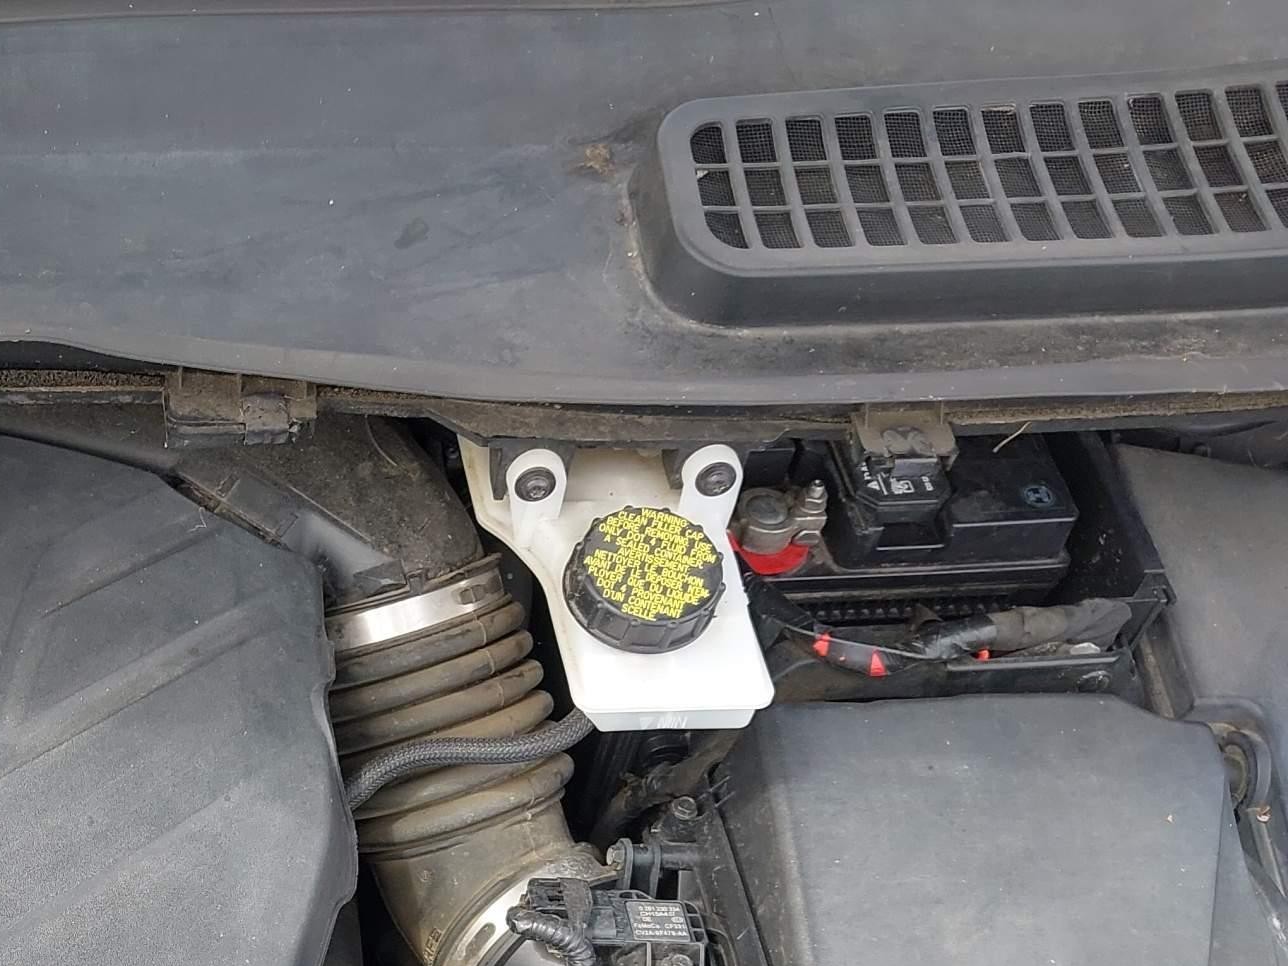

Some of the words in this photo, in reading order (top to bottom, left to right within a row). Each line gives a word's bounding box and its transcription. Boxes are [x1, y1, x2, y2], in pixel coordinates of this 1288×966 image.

[606, 517, 640, 533] BEFORE
[695, 541, 712, 553] USE
[618, 511, 648, 525] CLEAN
[651, 520, 682, 535] FILLER
[685, 530, 704, 540] CAP
[599, 523, 621, 536] ONLY
[626, 531, 645, 543] DOT
[649, 537, 656, 546] 4
[661, 540, 688, 554] FLUID
[690, 549, 717, 564] FROM
[603, 535, 611, 543] A
[616, 537, 650, 553] SEALED
[583, 555, 612, 570] AVANT
[614, 563, 627, 574] DE
[631, 567, 643, 579] LE
[594, 549, 641, 567] NETTOYER
[644, 563, 657, 574] LE
[662, 567, 704, 588] BOUCHON
[588, 567, 623, 583] PLOYER
[627, 577, 645, 588] QUE
[649, 582, 663, 594] DU
[666, 588, 700, 605] LIQUIDE
[596, 578, 616, 590] DOT
[620, 584, 627, 592] 4
[631, 587, 686, 610] PROVENANT
[621, 603, 657, 621] SCELLE
[627, 596, 683, 619] CONTENANT
